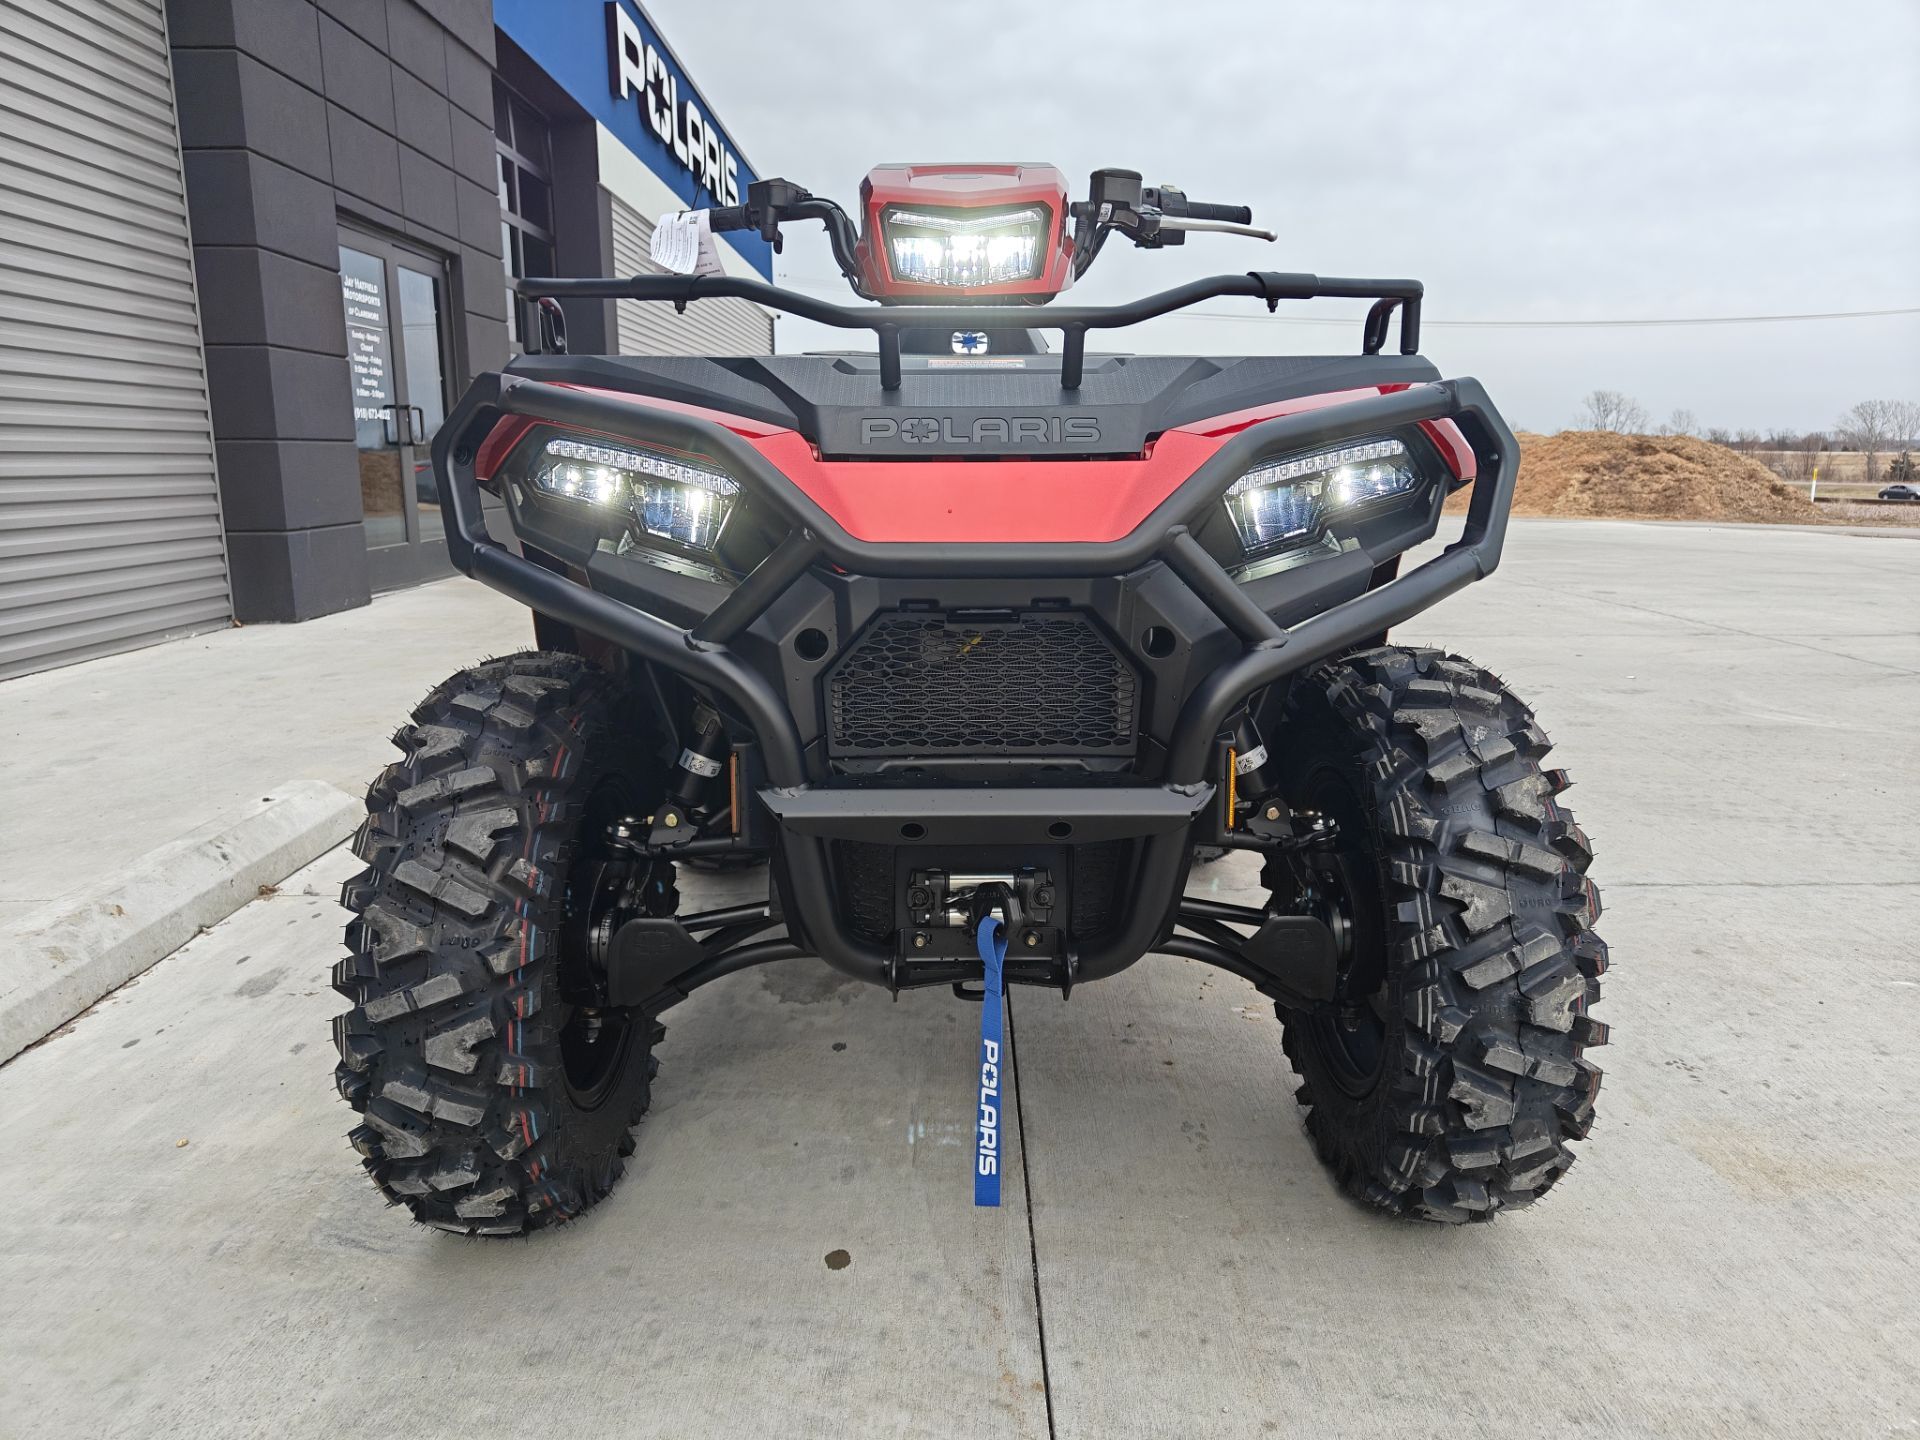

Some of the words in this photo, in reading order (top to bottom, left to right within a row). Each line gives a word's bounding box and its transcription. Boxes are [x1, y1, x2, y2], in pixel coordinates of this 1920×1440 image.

[614, 1, 740, 208] POLARIS
[860, 416, 1102, 446] POLARIS
[978, 1038, 999, 1177] POLARIS
